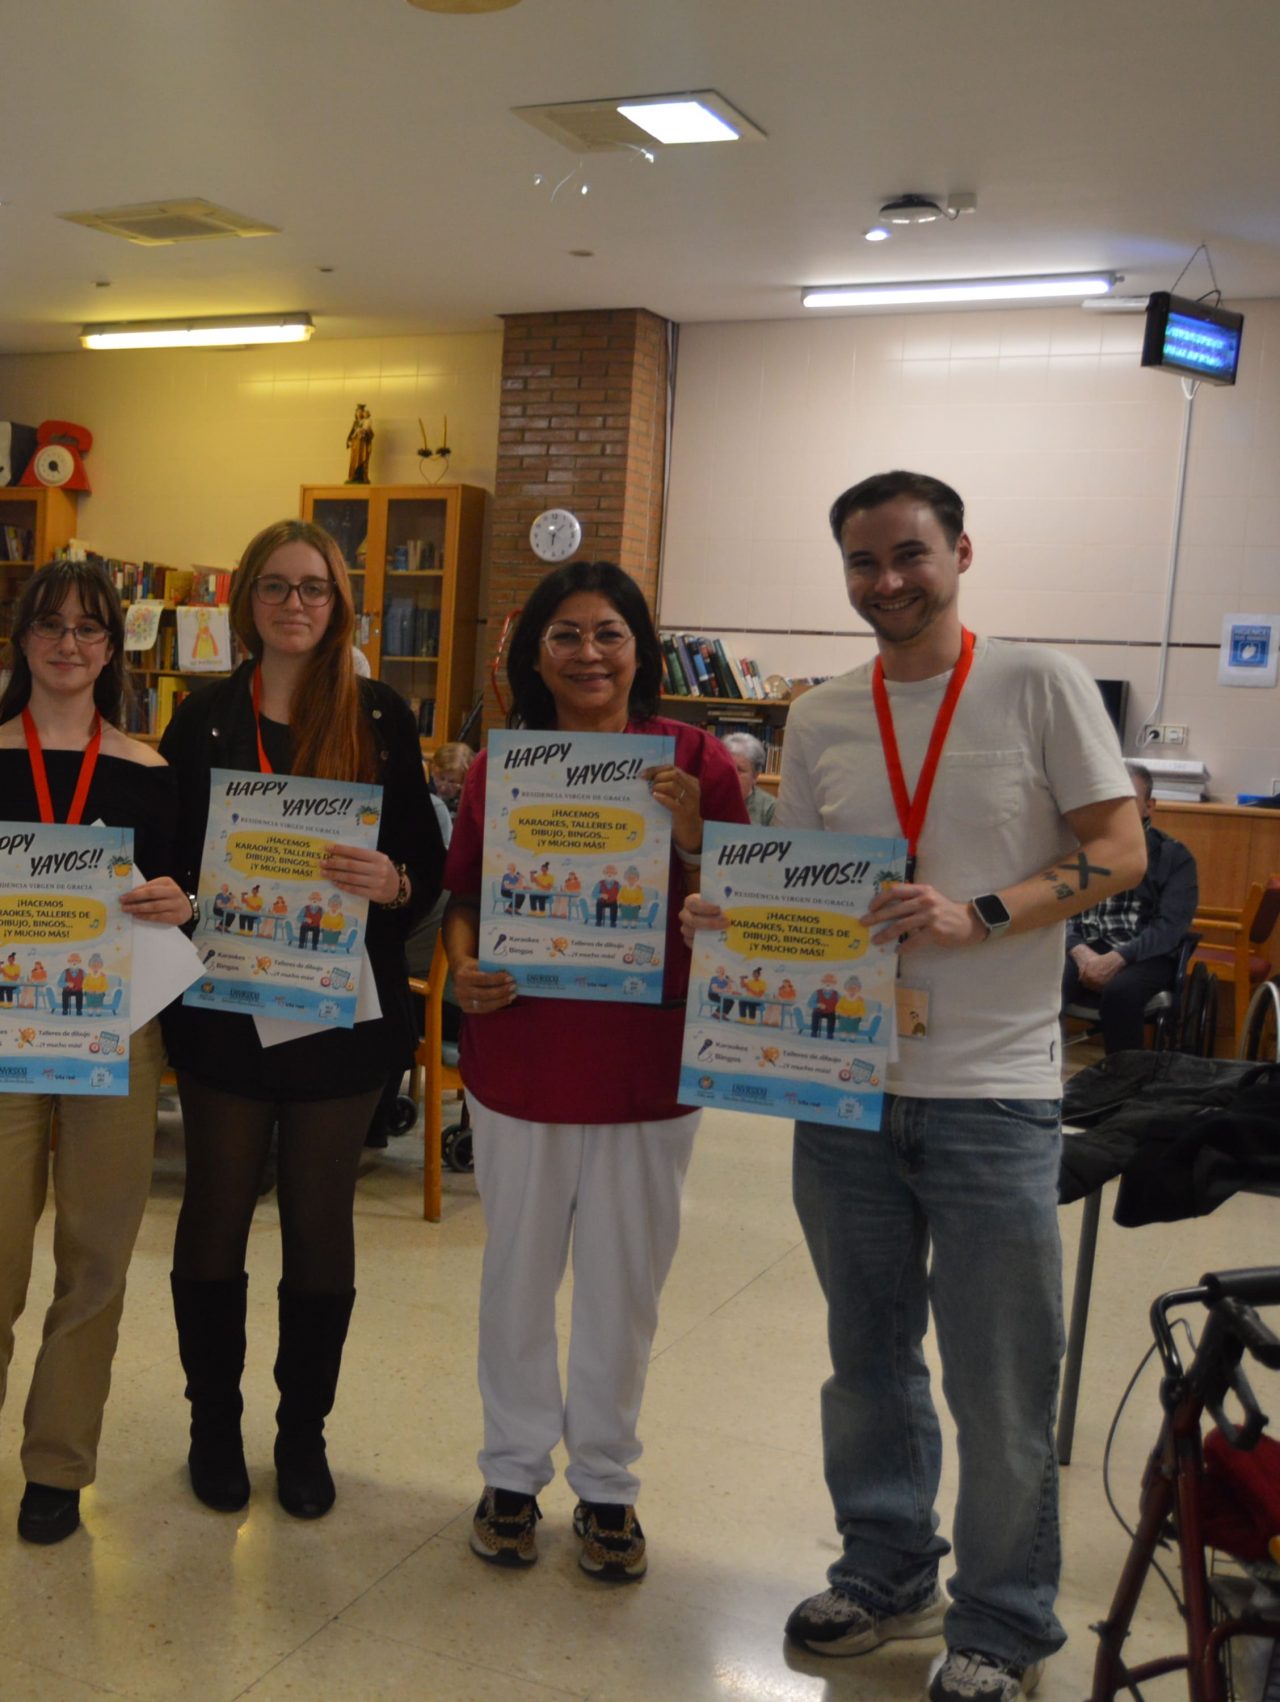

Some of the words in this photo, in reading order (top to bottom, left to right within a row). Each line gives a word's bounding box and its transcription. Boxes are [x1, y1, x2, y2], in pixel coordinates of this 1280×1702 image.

[504, 742, 572, 769] HAPPY
[566, 758, 643, 787] YAYOS!!
[225, 781, 288, 796] HAPPY
[282, 798, 353, 816] YAYOS!!
[552, 810, 600, 819] ¡HACEMOS
[518, 818, 569, 829] KARAOKES,
[571, 821, 613, 830] TALLERES
[615, 823, 628, 831] DE
[531, 829, 565, 839] DIBUJO,
[567, 831, 609, 840] BINGOS...
[266, 836, 311, 848] ¡HACEMOS
[537, 840, 546, 848] ¡Y
[583, 840, 606, 850] MÁS!
[235, 841, 282, 855] KARAOKES,
[283, 848, 322, 860] TALLERES
[717, 841, 792, 866] HAPPY
[30, 848, 103, 876] YAYOS!!
[245, 853, 277, 864] DIBUJO,
[250, 864, 258, 872] ¡Y
[260, 865, 291, 874] MUCHO
[291, 867, 313, 877] MÁS!
[784, 860, 871, 889] YAYOS!!
[17, 900, 64, 908] ¡HACEMOS
[766, 912, 820, 924] ¡HACEMOS
[48, 930, 70, 938] MÁS!
[730, 919, 785, 933] KARAOKES,
[787, 925, 833, 937] TALLERES
[836, 929, 849, 938] DE
[743, 933, 781, 944] DIBUJO,
[783, 936, 829, 947] BINGOS...
[749, 944, 758, 953] ¡Y
[761, 945, 798, 954] MUCHO
[799, 947, 825, 957] MÁS!
